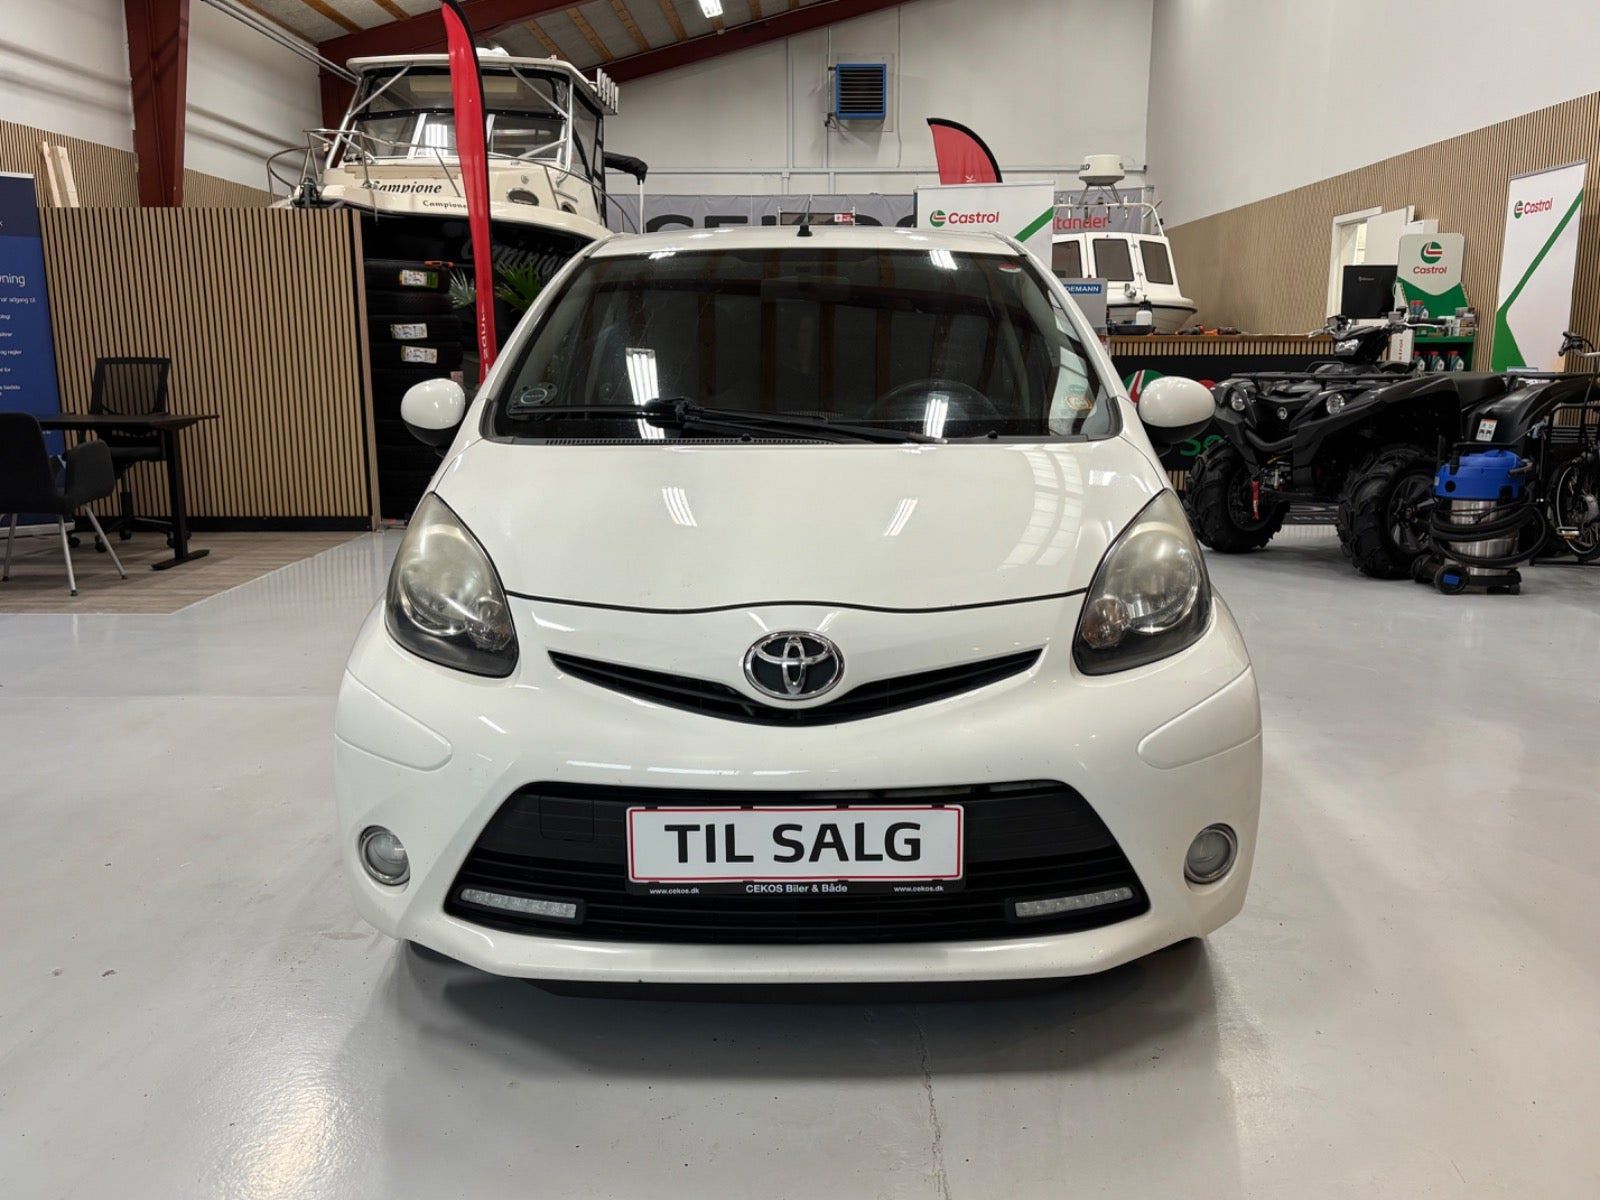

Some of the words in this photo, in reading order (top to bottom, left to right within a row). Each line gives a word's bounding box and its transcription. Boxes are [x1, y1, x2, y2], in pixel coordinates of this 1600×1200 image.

[1524, 197, 1553, 215] Castrol
[948, 211, 1000, 224] Castrol
[1053, 214, 1108, 230] tander
[1413, 266, 1448, 275] Castrol
[664, 823, 754, 863] TIL
[772, 822, 921, 863] SALG
[649, 887, 700, 895] www.cekos.dk
[745, 884, 783, 894] CEKOS
[786, 884, 809, 893] Biler
[811, 884, 819, 893] &
[822, 882, 848, 893] Både
